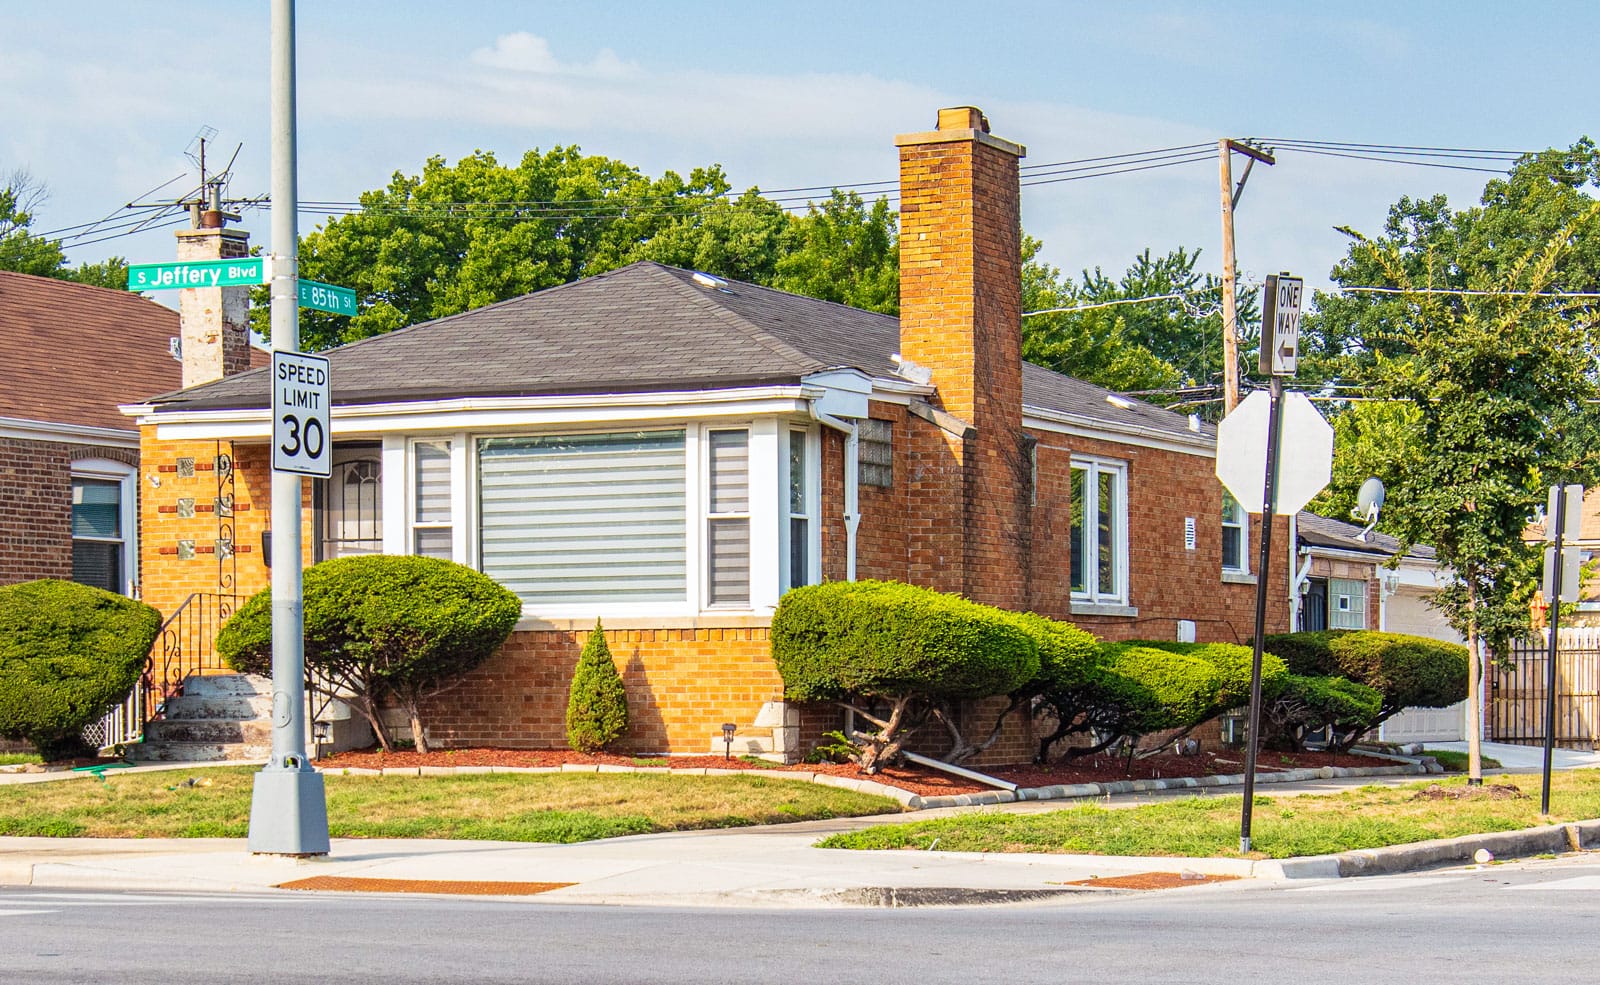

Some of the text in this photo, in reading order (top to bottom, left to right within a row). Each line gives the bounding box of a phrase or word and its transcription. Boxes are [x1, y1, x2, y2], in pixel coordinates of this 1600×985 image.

[137, 266, 257, 287] S Jeffery Blvd
[301, 286, 351, 309] E 85th St
[1280, 286, 1299, 308] ONE
[1278, 312, 1297, 334] WAY
[278, 362, 325, 386] SPEED
[284, 388, 320, 409] LIMIT
[281, 414, 324, 460] 30
